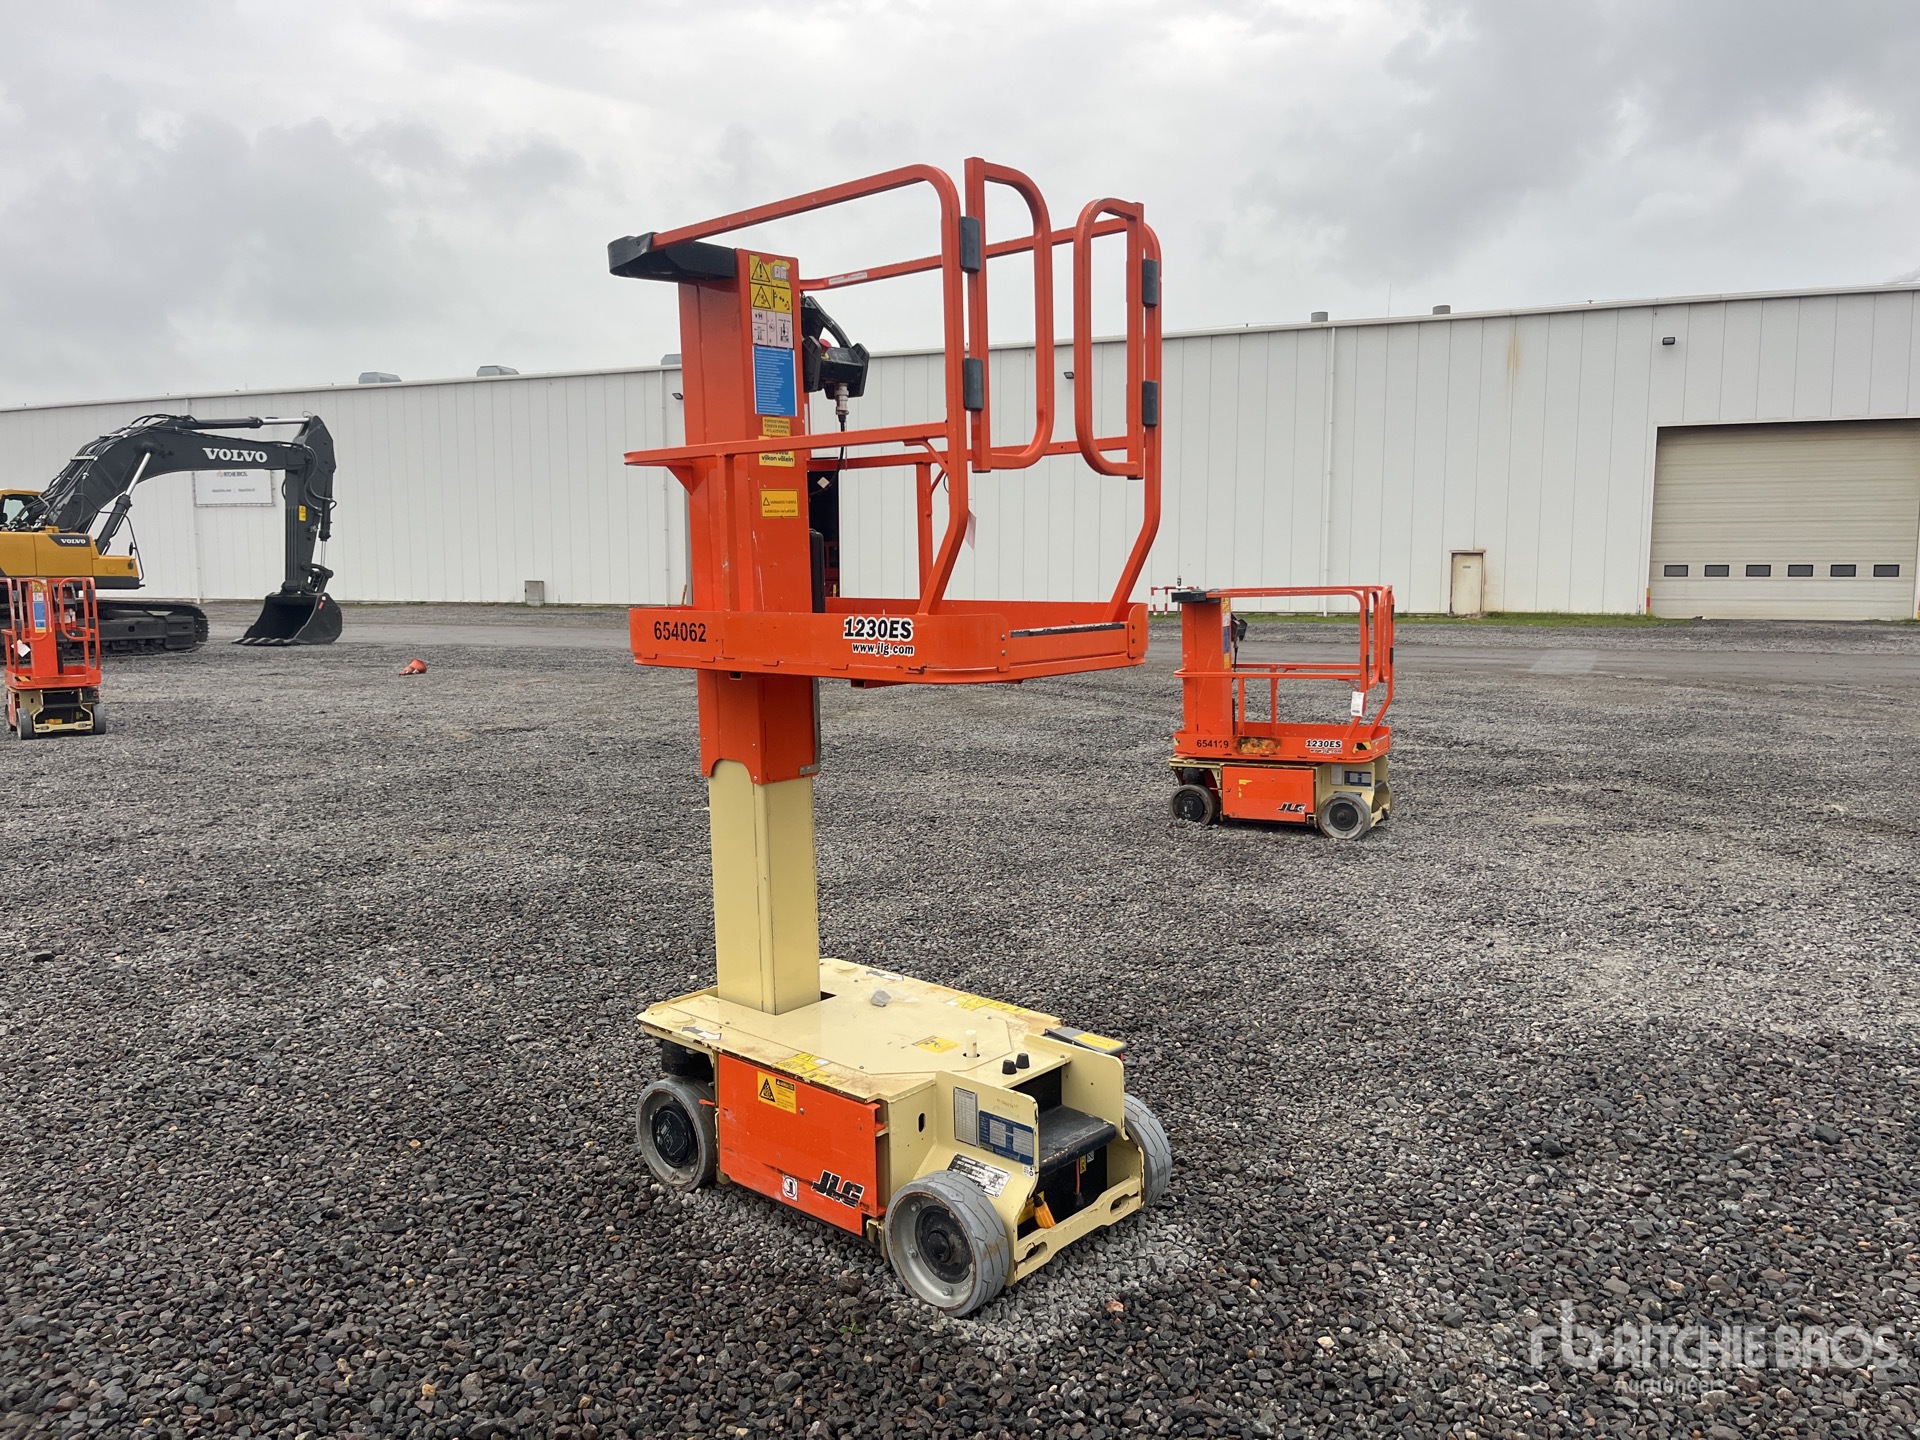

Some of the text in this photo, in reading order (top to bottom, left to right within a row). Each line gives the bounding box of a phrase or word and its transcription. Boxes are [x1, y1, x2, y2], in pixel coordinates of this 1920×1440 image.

[202, 447, 268, 463] VOLVO
[654, 620, 707, 643] 654062
[843, 616, 914, 641] 1230ES
[852, 642, 915, 657] www.jlg.com
[1305, 739, 1343, 749] 1230ES
[811, 1169, 865, 1209] JLG
